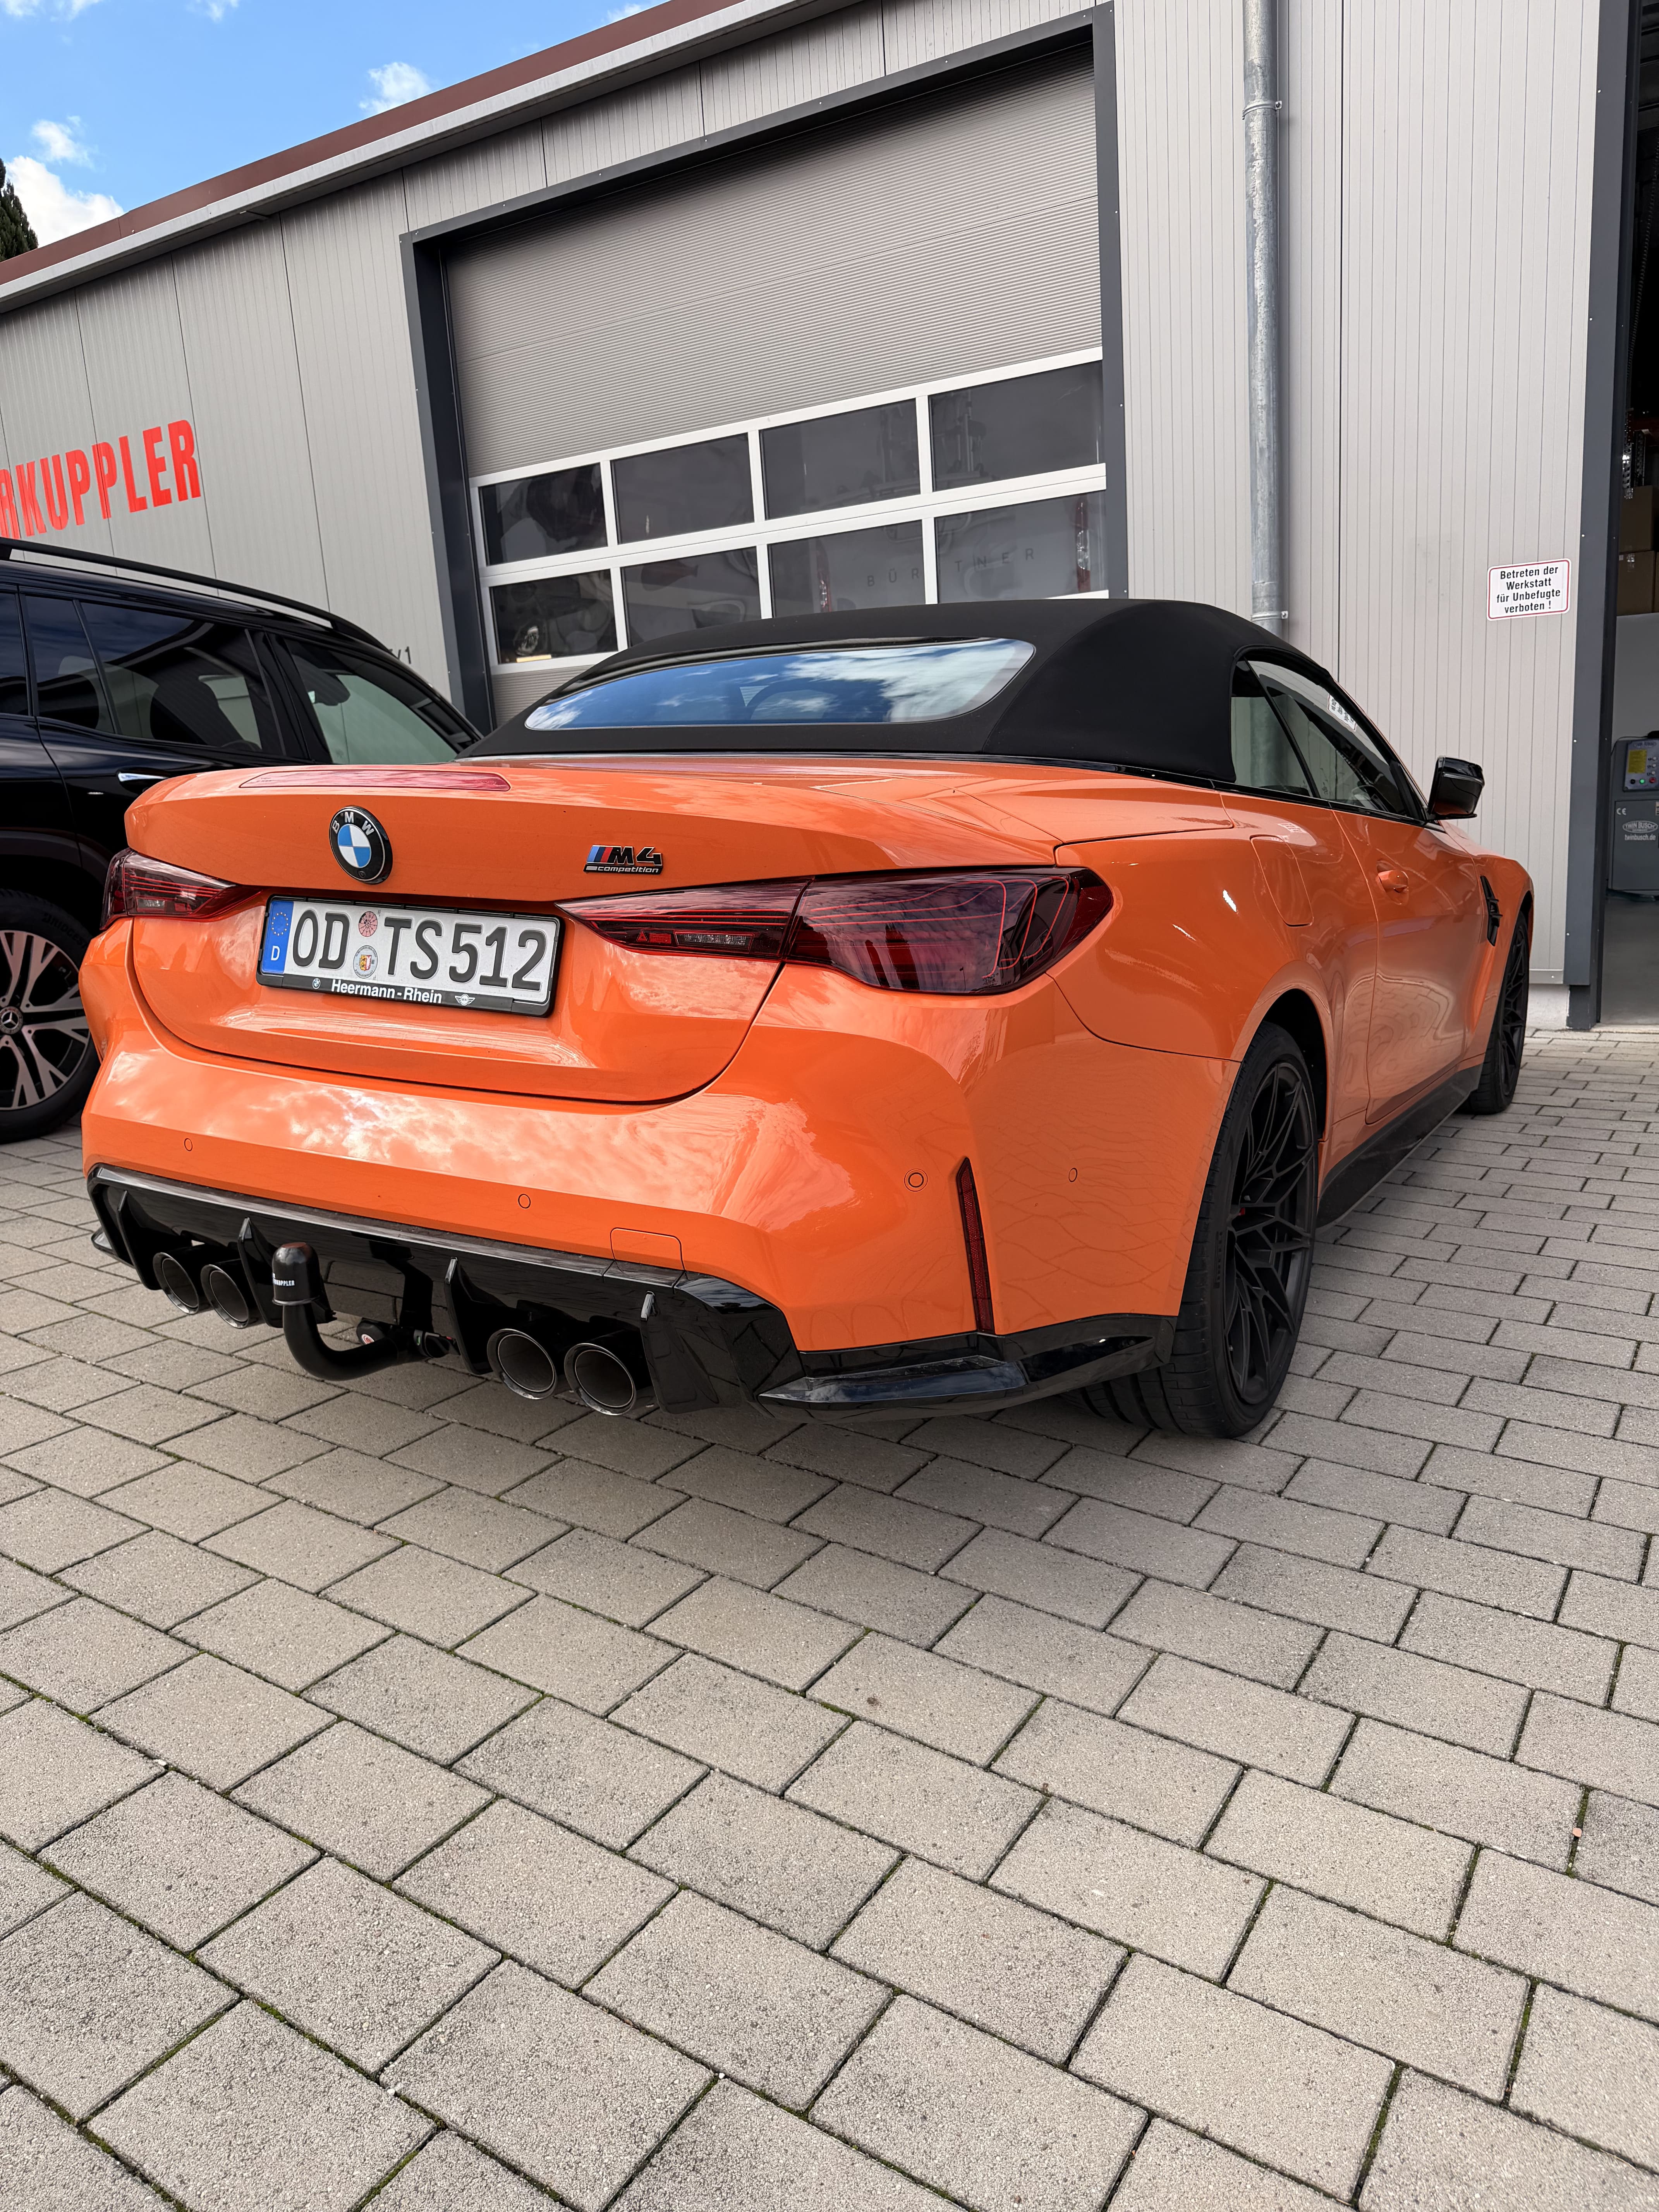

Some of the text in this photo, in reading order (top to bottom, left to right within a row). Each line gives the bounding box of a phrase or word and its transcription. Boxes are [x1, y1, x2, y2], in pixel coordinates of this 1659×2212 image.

[867, 548, 1034, 587] BÜRTNER
[1500, 566, 1558, 579] Betreten der
[1506, 577, 1551, 590] Werkstatt
[1496, 589, 1561, 603] für Unbefugte
[1504, 603, 1545, 613] verboten
[332, 811, 375, 836] BMW
[292, 909, 350, 970] OD
[270, 945, 280, 961] D
